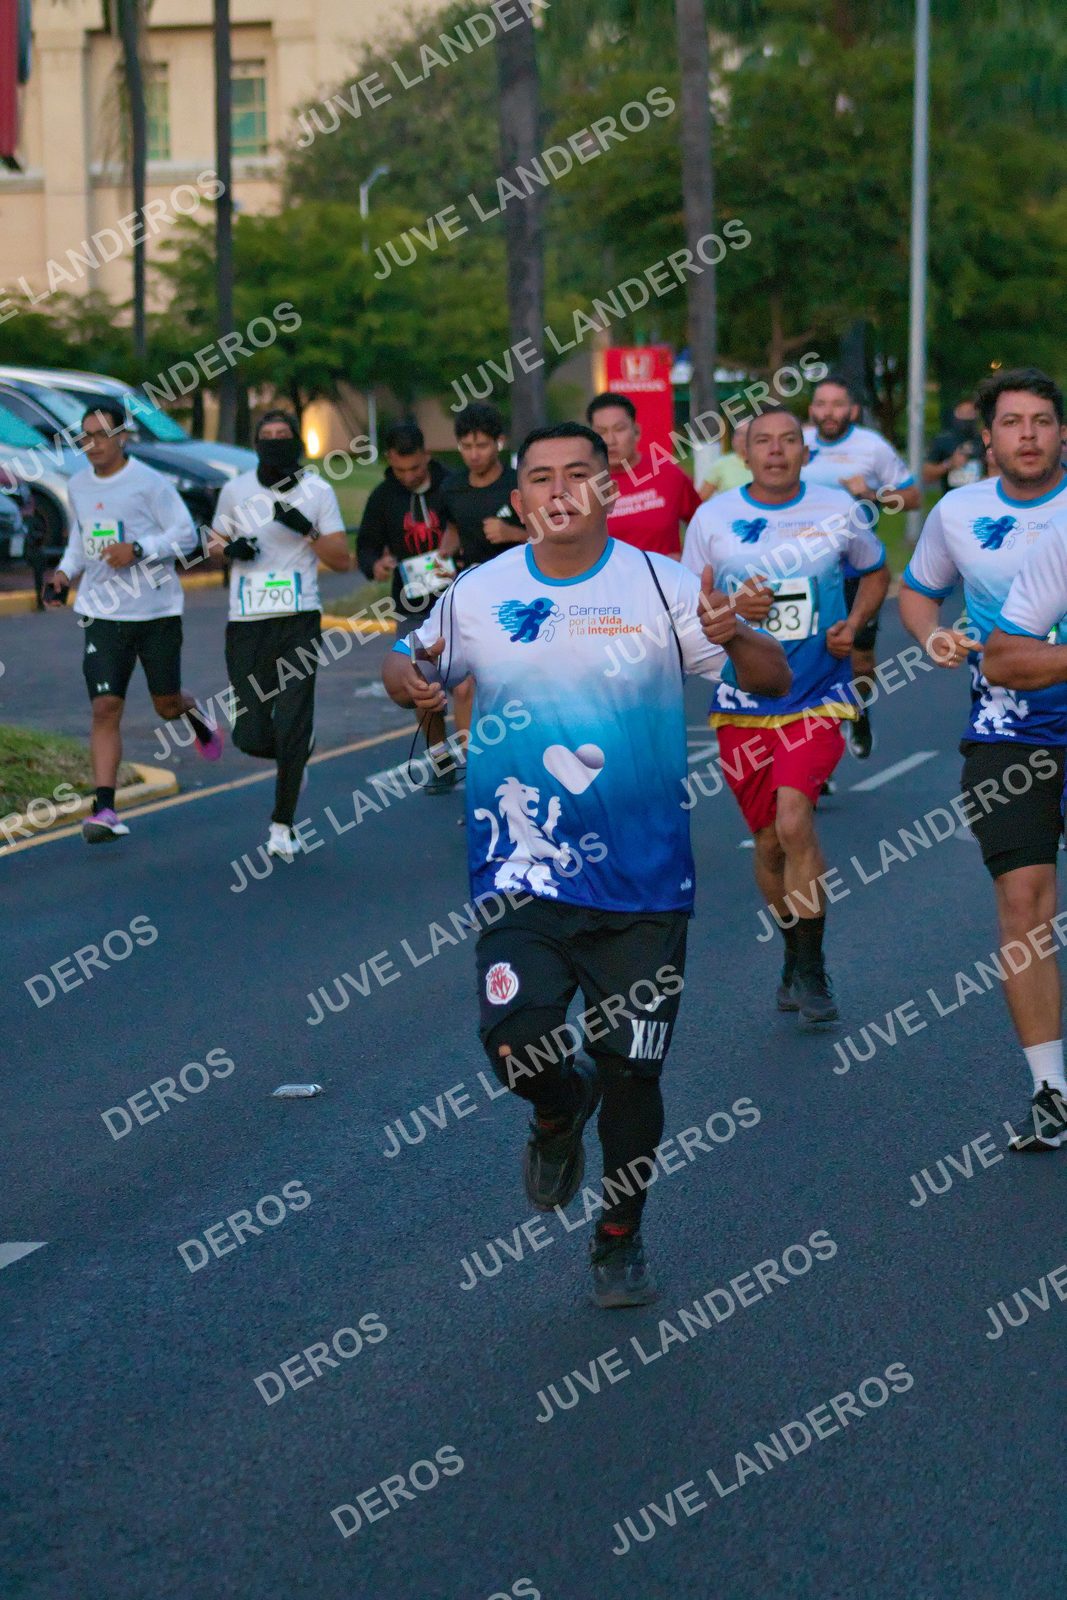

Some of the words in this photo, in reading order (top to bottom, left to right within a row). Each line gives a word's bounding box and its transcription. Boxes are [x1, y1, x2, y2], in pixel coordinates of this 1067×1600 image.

[246, 588, 294, 609] 1790
[569, 605, 621, 616] Carrera
[569, 619, 586, 627] por
[588, 616, 597, 624] la
[598, 615, 622, 624] Vida
[757, 605, 801, 632] 83
[569, 629, 575, 637] y
[577, 626, 585, 635] la
[588, 624, 642, 636] Integridad
